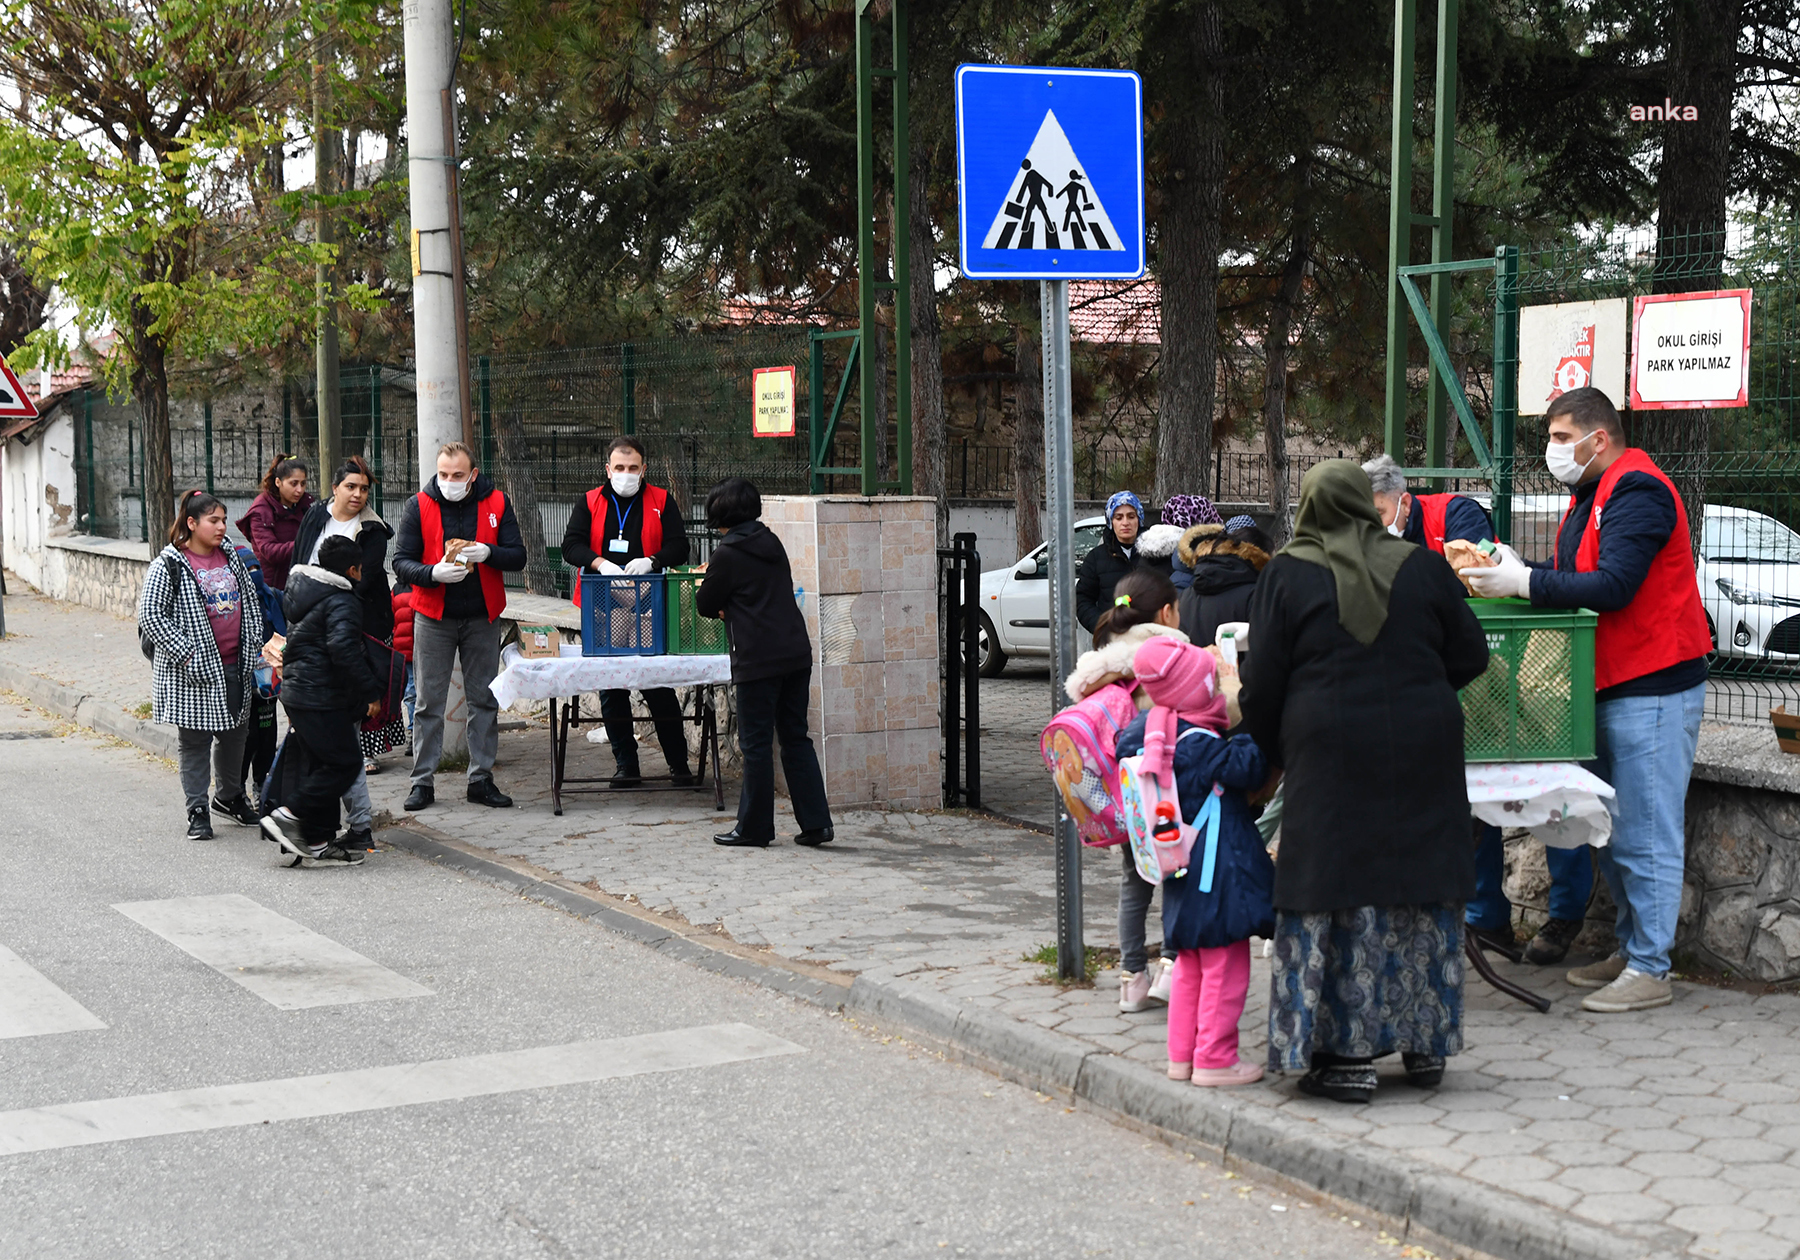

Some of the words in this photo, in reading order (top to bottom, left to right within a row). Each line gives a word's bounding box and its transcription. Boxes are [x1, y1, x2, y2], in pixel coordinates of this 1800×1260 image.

[1657, 334, 1686, 348] OKUL
[1689, 329, 1722, 349] GİRİŞİ
[1647, 358, 1674, 372] PARK
[1678, 356, 1731, 371] YAPILMAZ
[762, 392, 773, 401] OKUL
[759, 406, 769, 415] PARK
